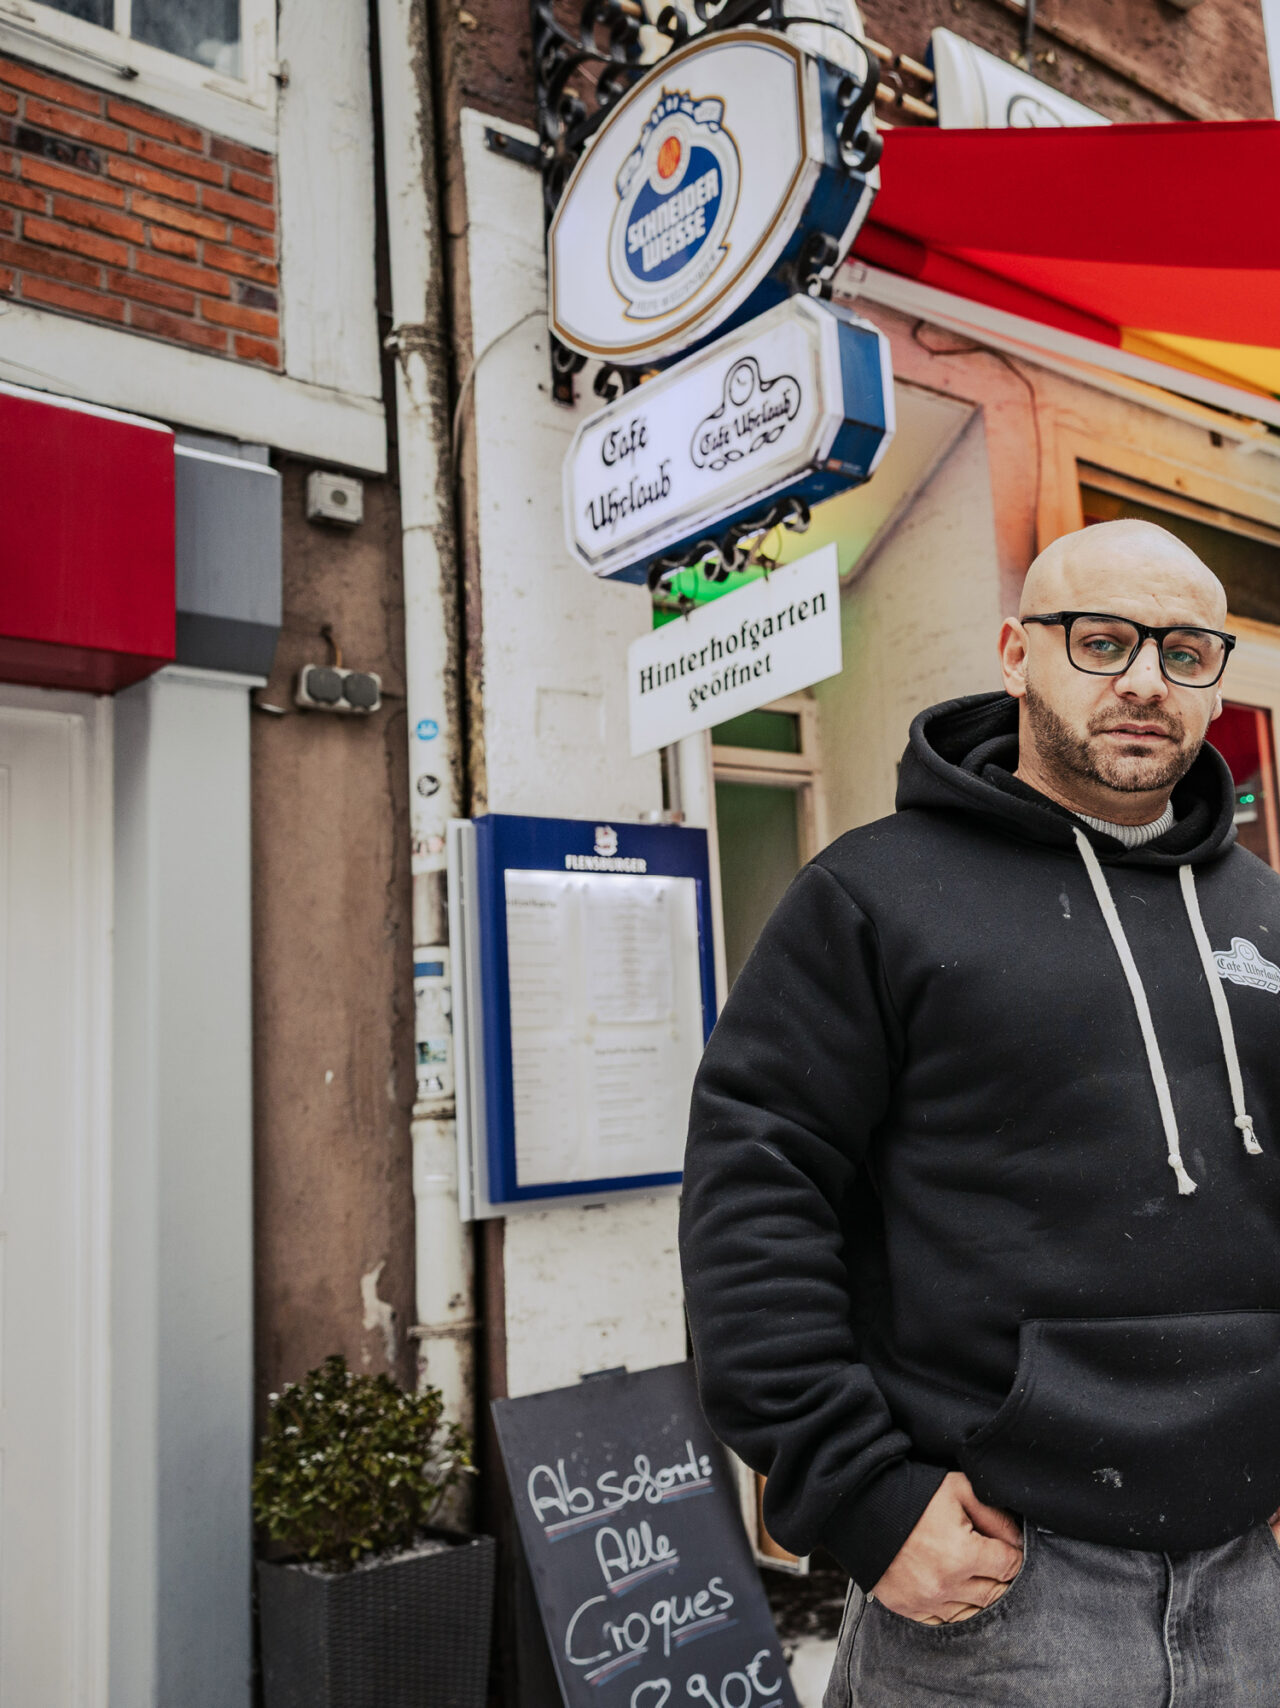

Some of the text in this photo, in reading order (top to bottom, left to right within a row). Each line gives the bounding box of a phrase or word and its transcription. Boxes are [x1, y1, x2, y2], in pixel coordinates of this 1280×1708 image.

[627, 167, 720, 254] SCHNEIDER
[641, 206, 707, 273] WEISSE
[734, 388, 792, 438] Uhrlaub
[585, 459, 672, 533] Uhrlaub
[638, 592, 827, 695] Hinterhofgarten
[688, 653, 772, 711] geöffnet
[565, 853, 647, 873] FLENSBURGER
[1217, 958, 1280, 982] Cafe Uhrlaub
[595, 1520, 678, 1584] Alle
[565, 1576, 735, 1666] Croques
